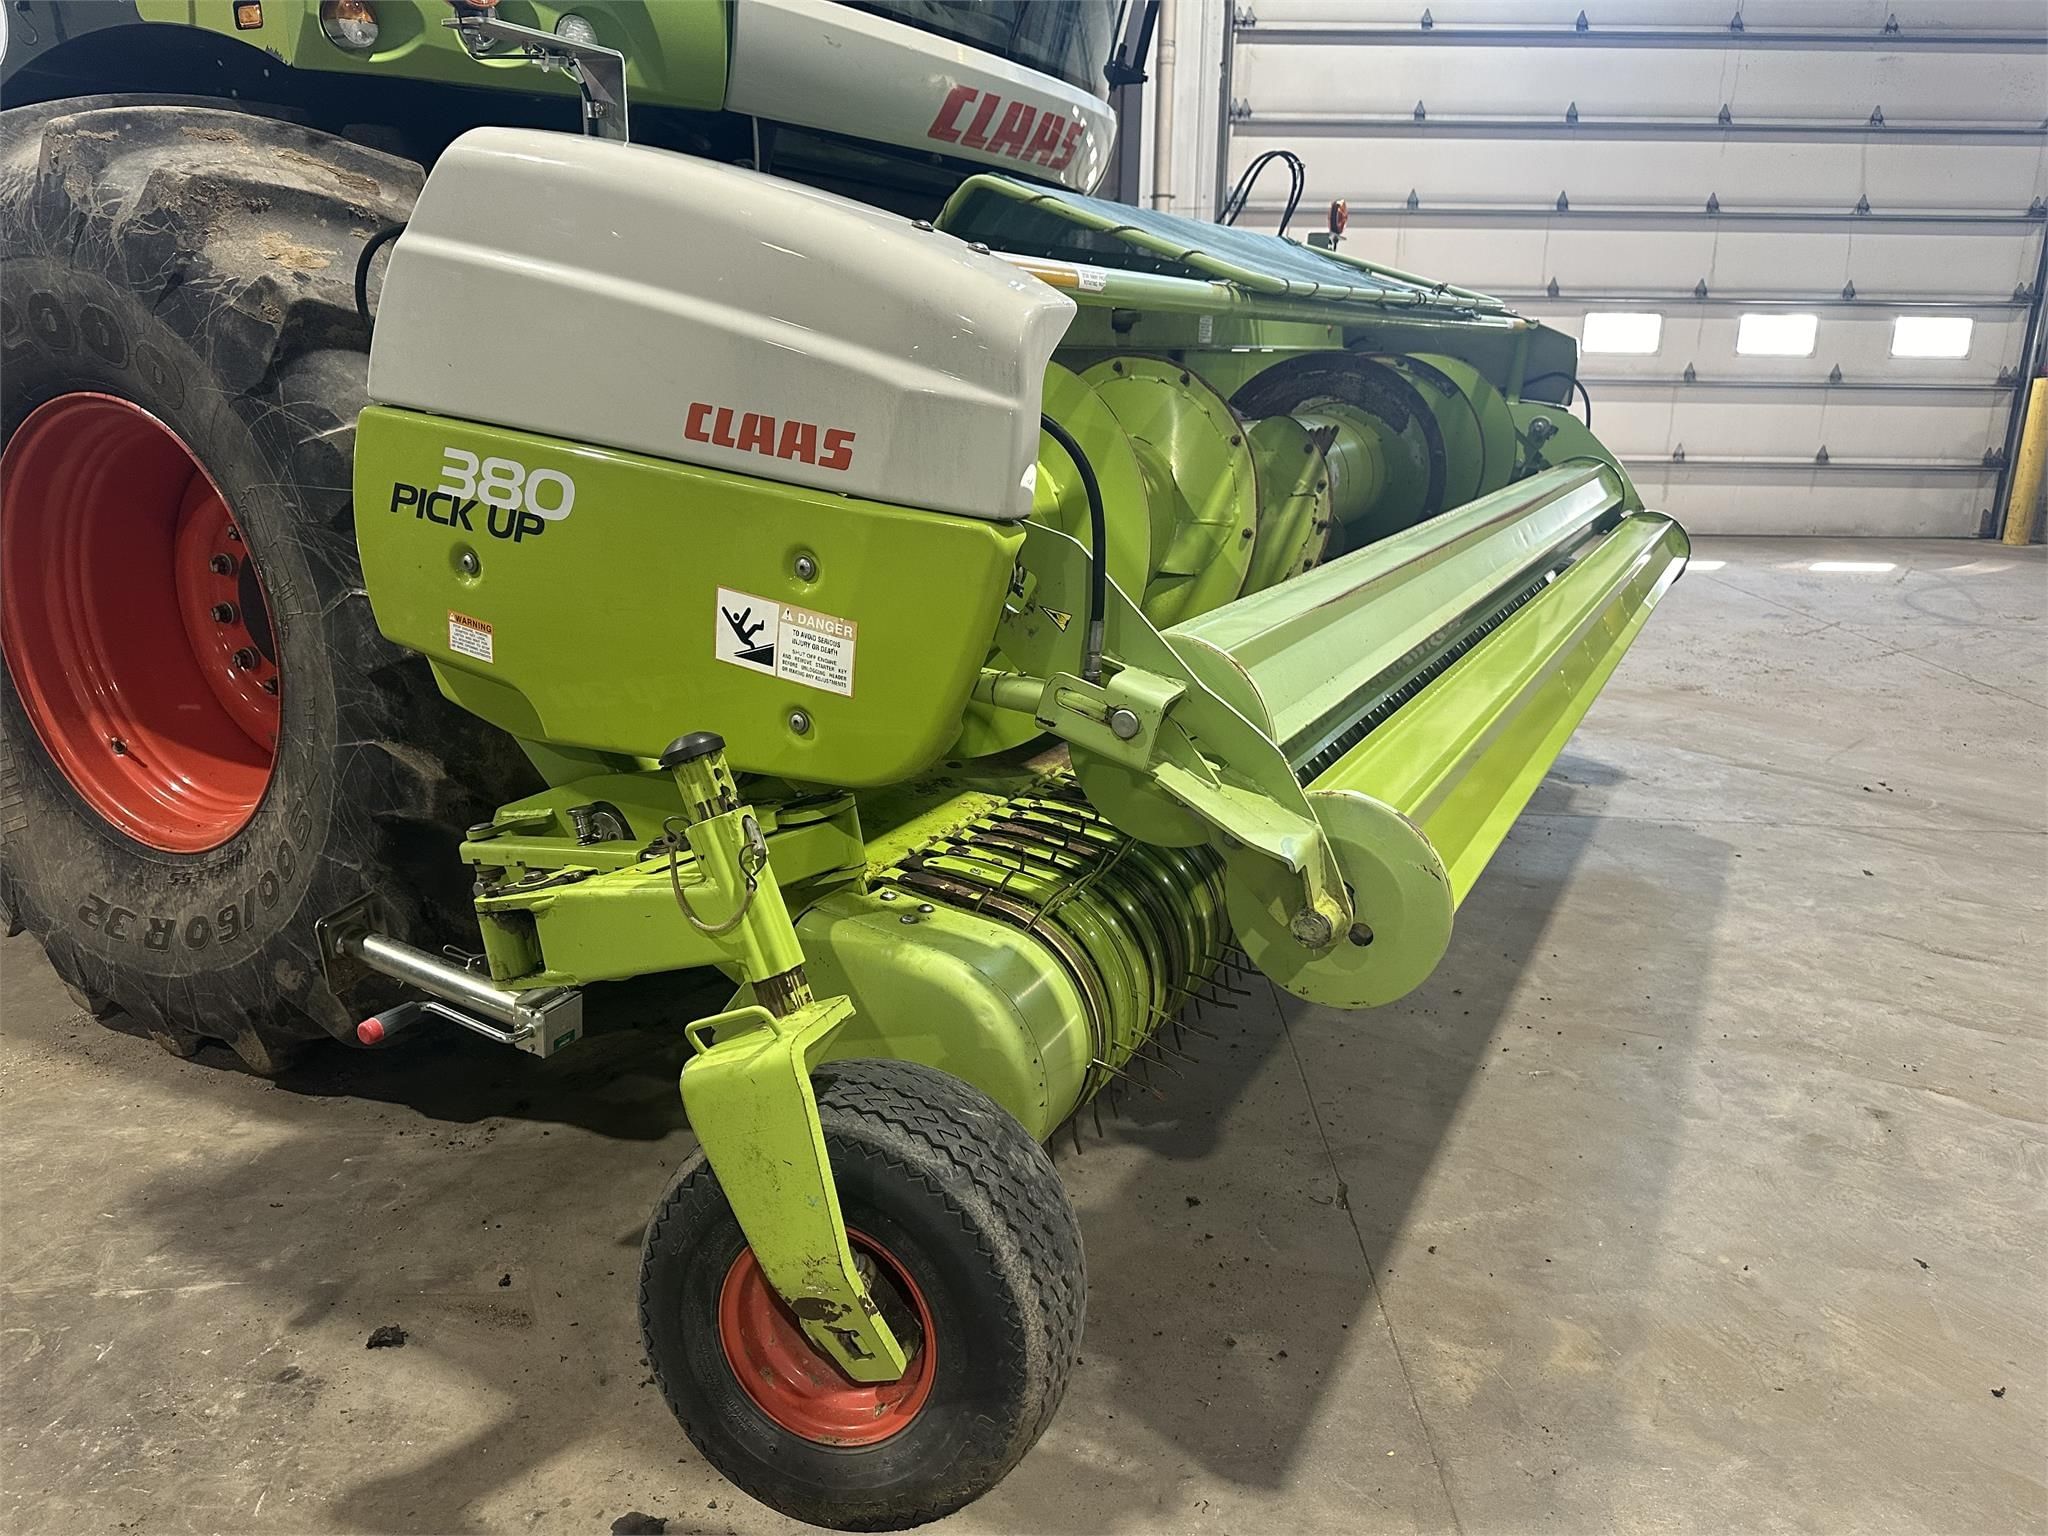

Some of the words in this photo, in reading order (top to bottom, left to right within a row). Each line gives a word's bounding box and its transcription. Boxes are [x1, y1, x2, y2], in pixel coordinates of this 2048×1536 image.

[927, 84, 1085, 171] CLAAS
[684, 402, 856, 471] CLAAS
[437, 446, 576, 521] 380
[390, 481, 479, 532] PICK
[487, 504, 545, 543] UP
[454, 614, 492, 633] WARNING
[793, 629, 799, 637] TO
[801, 631, 816, 641] AVOID
[818, 636, 840, 648] SERIOUS
[798, 613, 853, 638] DANGER
[792, 638, 811, 648] INJURY
[812, 643, 820, 651] OR
[821, 646, 838, 656] DEATH
